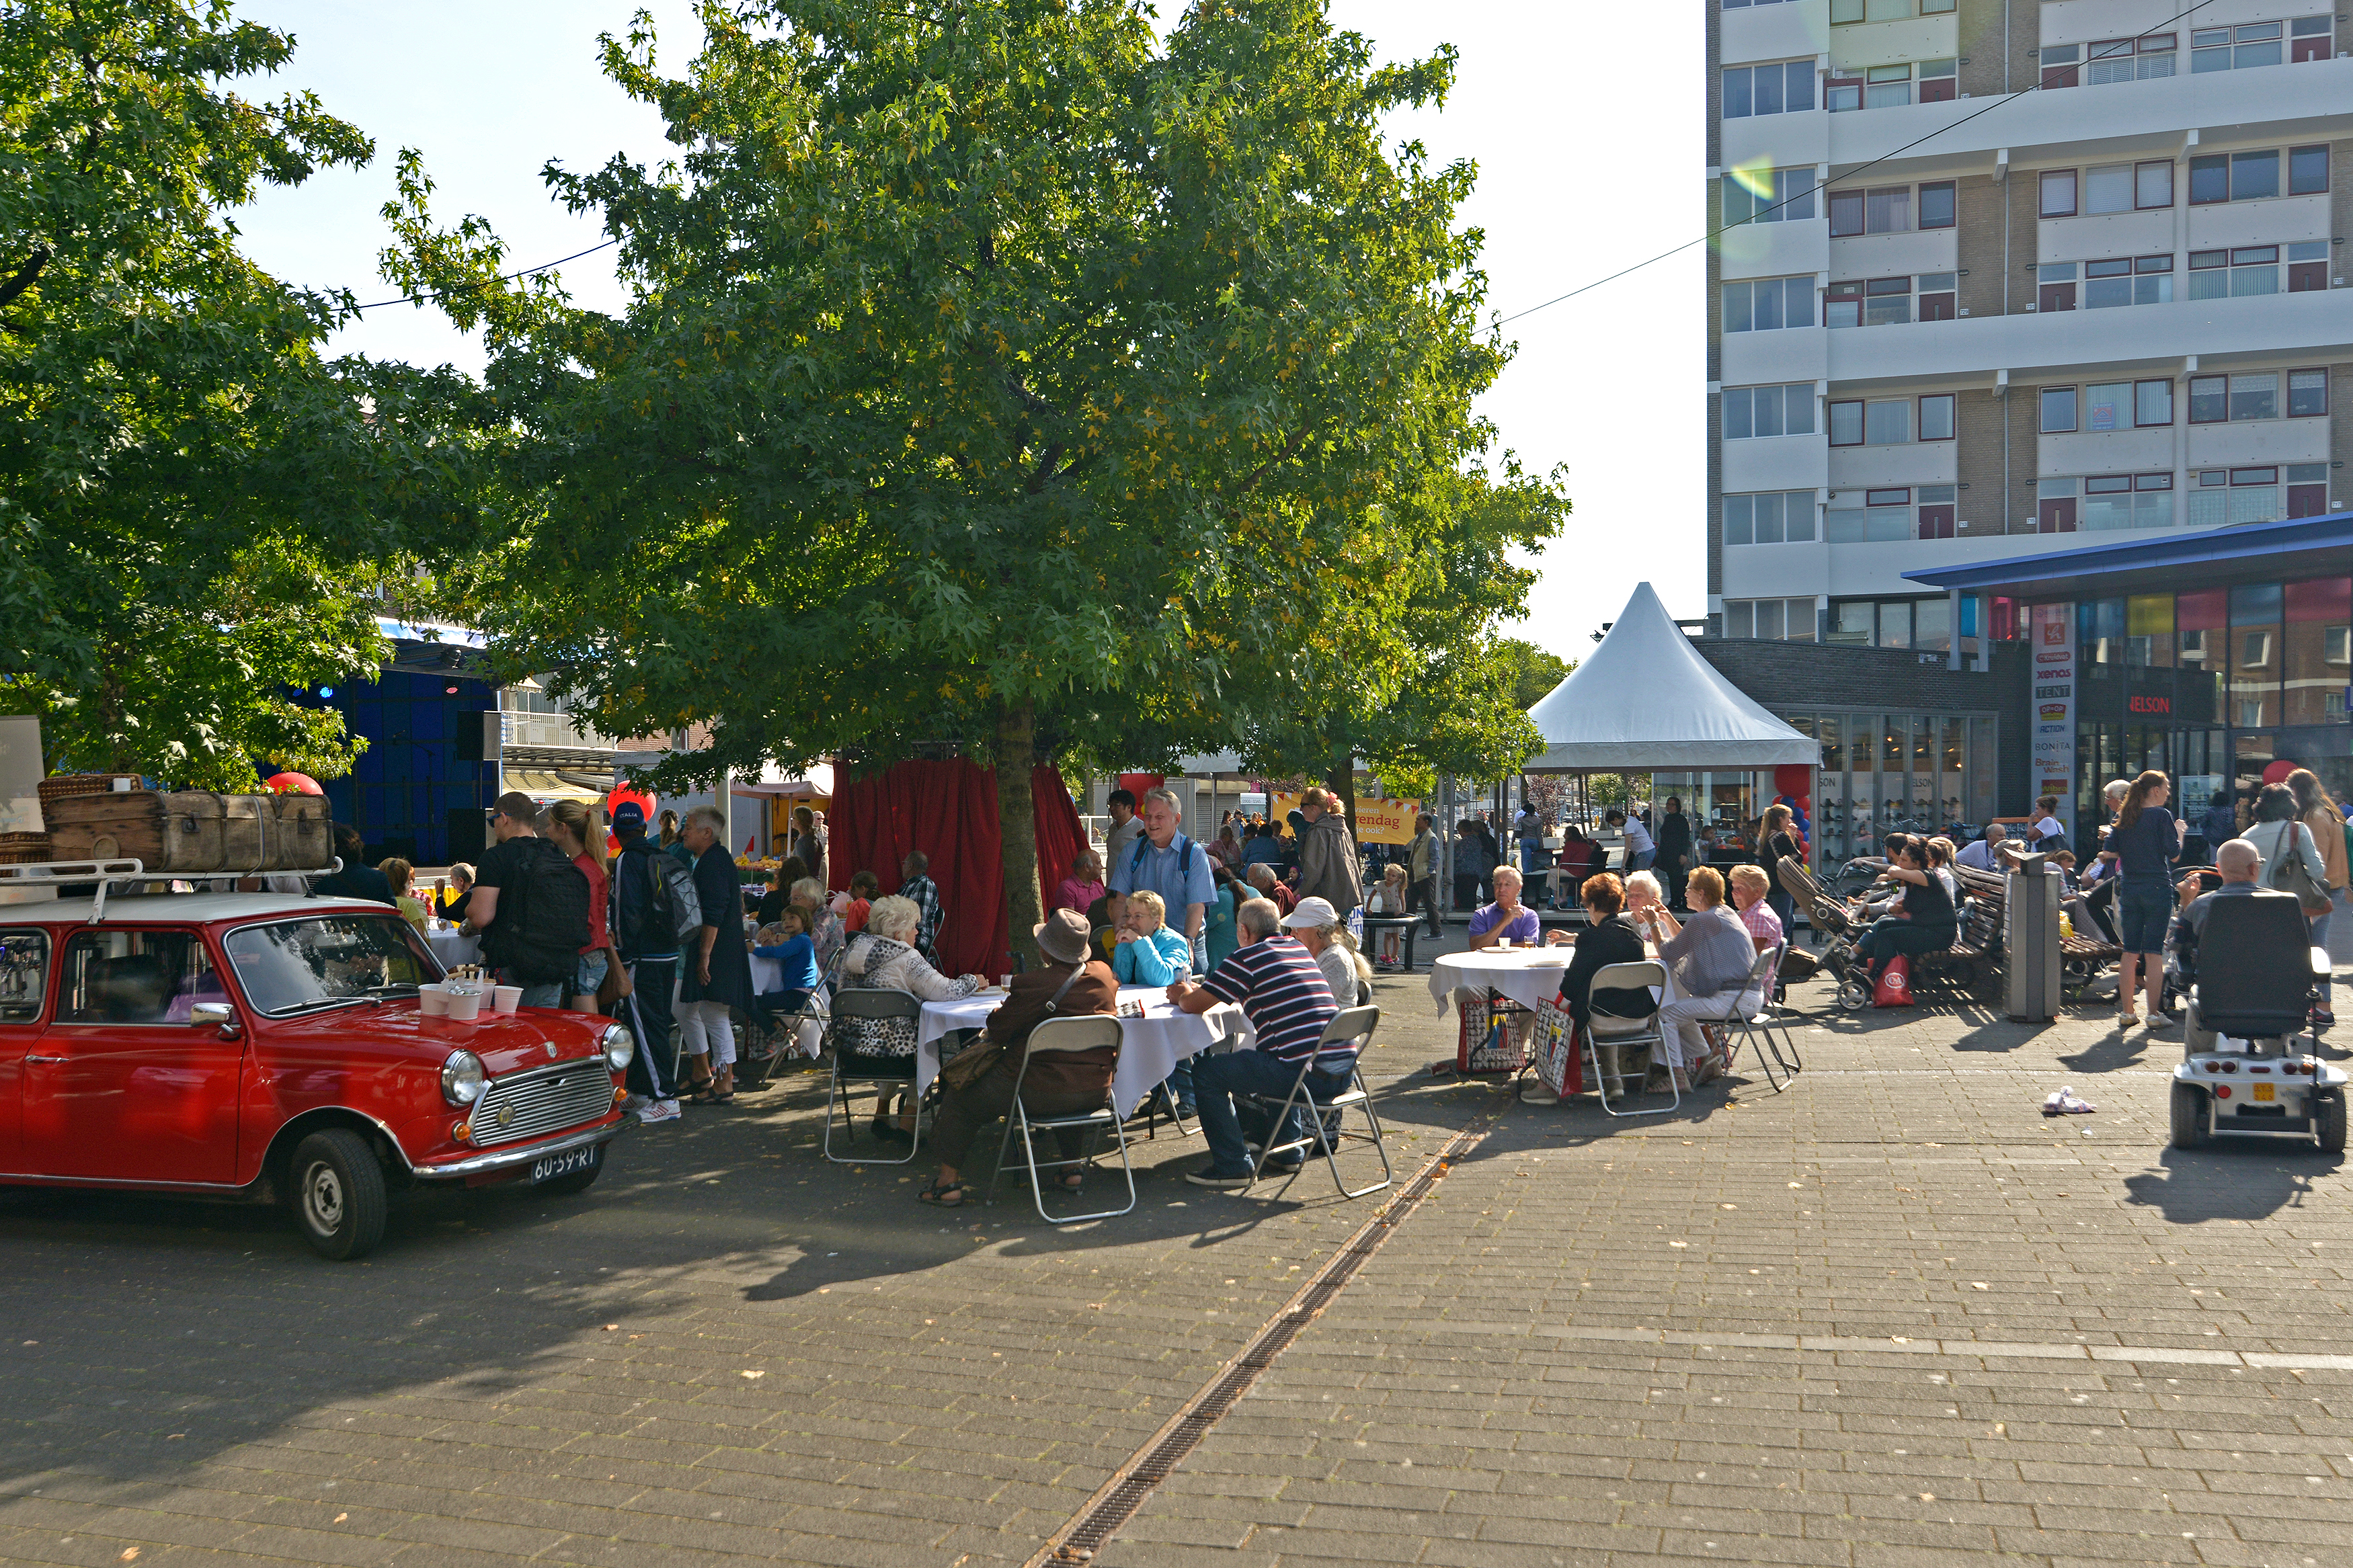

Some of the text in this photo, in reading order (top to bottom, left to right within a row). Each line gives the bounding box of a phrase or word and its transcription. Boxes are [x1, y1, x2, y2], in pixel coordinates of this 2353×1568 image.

[2044, 653, 2069, 661] Kruidvat
[2036, 669, 2071, 679] xenos
[2038, 686, 2069, 698] TENT
[2040, 725, 2065, 733] ACTION
[2035, 757, 2059, 766] Brain
[2044, 765, 2069, 774] Wash
[1356, 825, 1385, 834] je ook?
